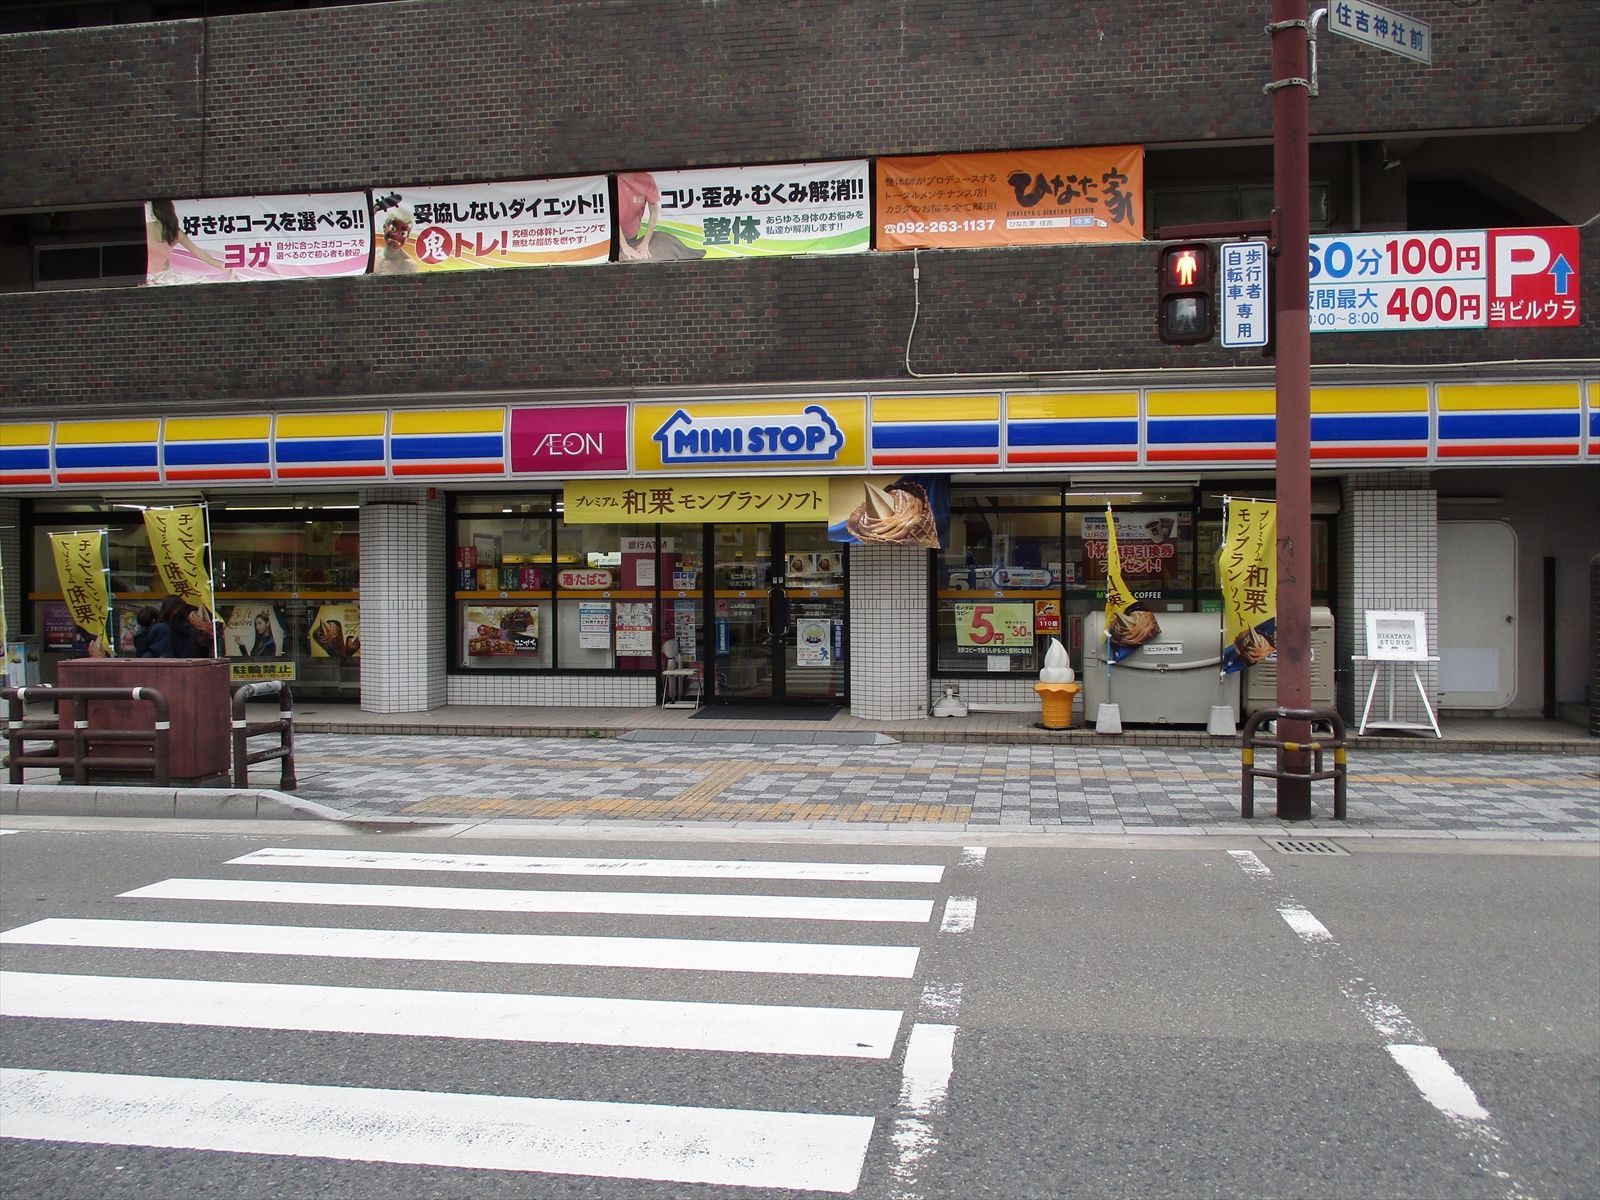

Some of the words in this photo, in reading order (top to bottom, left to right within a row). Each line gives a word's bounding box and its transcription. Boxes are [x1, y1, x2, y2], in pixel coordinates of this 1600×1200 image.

[1336, 2, 1424, 52] 住吉神社前
[413, 193, 604, 225] 妥協しないダイエット!!
[661, 179, 864, 209] コリ・歪み・むくみ解消!!
[1006, 167, 1135, 226] ひなた家
[182, 209, 365, 237] 好きなコースを選べる!!
[512, 224, 606, 238] 究極の体幹トレーニングで
[702, 215, 761, 246] 整体
[765, 210, 864, 225] あらゆる身体のお悩みを
[765, 222, 843, 236] 私達が解消します!!
[896, 219, 996, 234] 092-263-1137
[224, 241, 273, 269] ヨガ
[276, 238, 366, 251] 自分に合ったヨガコースを
[276, 248, 361, 260] 選べるので初心者も歓迎
[420, 229, 508, 264] 鬼トレ!
[1385, 237, 1481, 275] 100円
[1227, 251, 1243, 300] 自転車
[1245, 249, 1262, 299] 歩行者
[1495, 235, 1551, 297] P
[1386, 285, 1481, 322] 400円
[1490, 299, 1577, 322] 当ビルウラ
[1236, 303, 1253, 338] 専用
[673, 427, 744, 455] MINI
[747, 425, 827, 454] STOP
[1085, 541, 1175, 560] 1杯料引換券
[1134, 591, 1162, 599] COFFEE
[969, 606, 1006, 645] 5円
